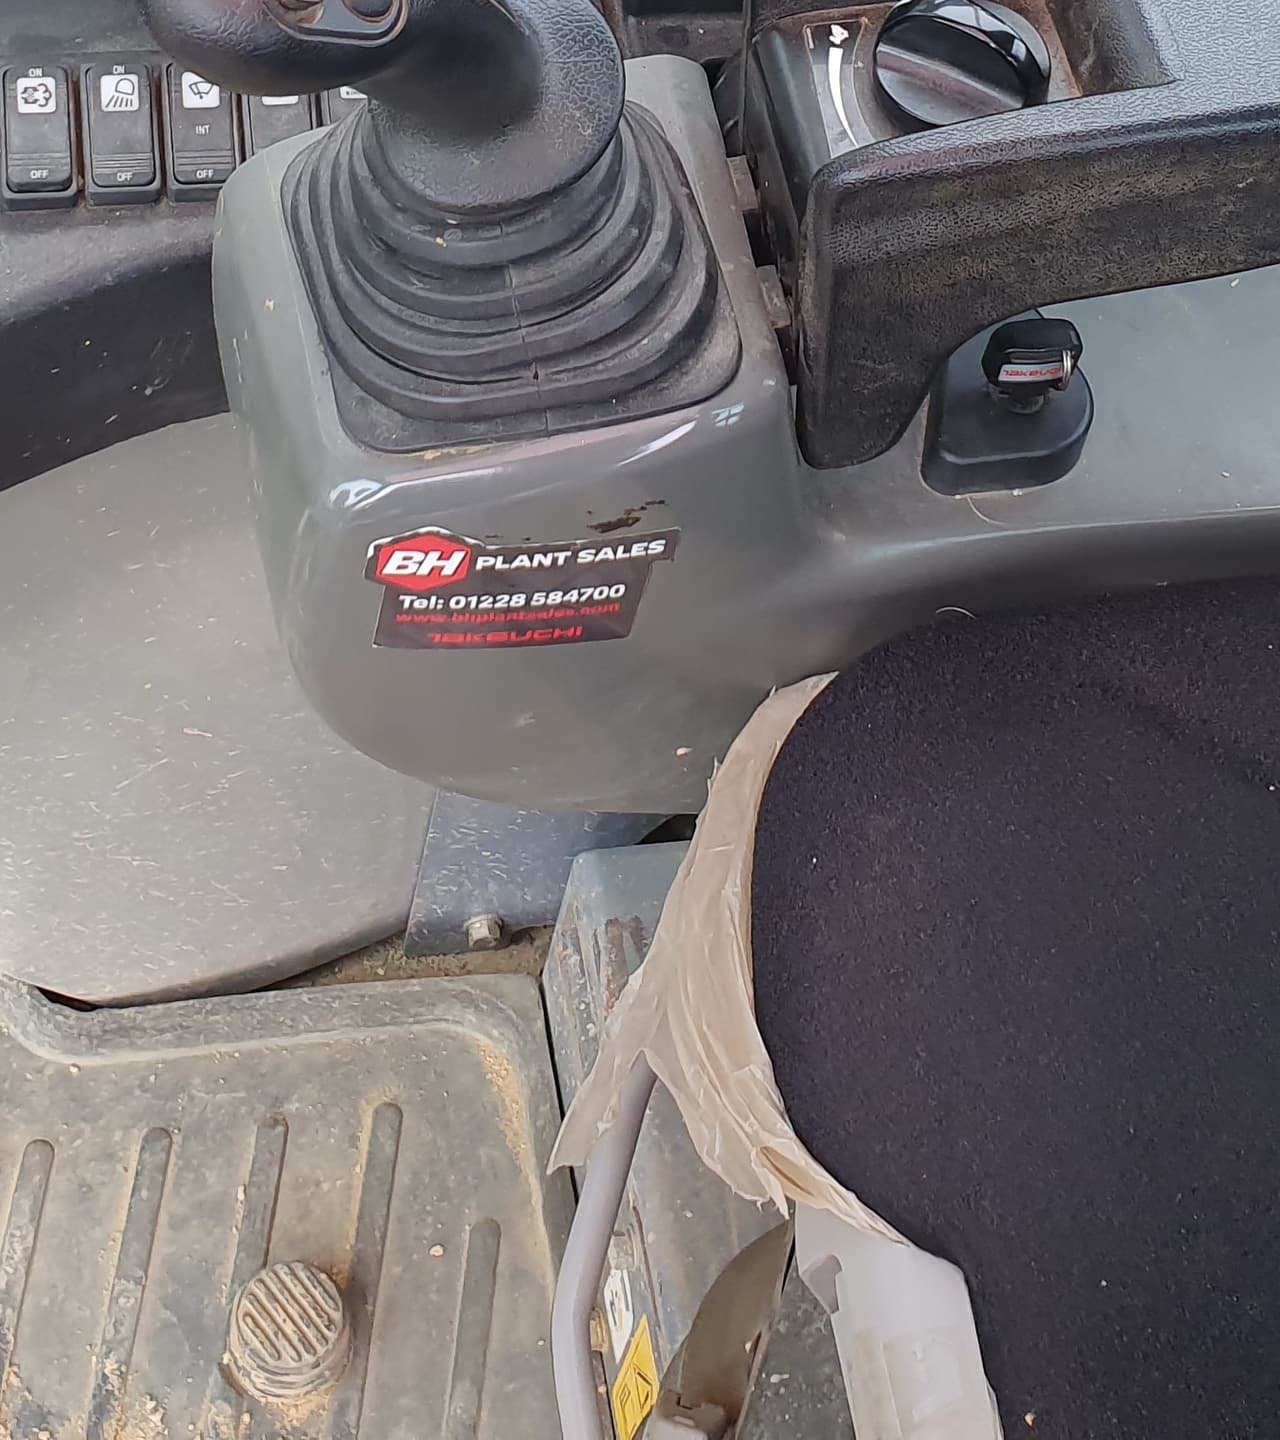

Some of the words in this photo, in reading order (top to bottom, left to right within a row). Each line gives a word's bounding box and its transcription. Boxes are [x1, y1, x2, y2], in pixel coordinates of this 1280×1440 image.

[28, 68, 43, 77] ON
[112, 65, 125, 75] ON
[195, 125, 210, 135] INT
[30, 169, 48, 179] OFF
[117, 172, 133, 182] OFF
[196, 169, 214, 179] OFF
[382, 550, 467, 576] BH
[476, 551, 571, 571] PLANT
[577, 540, 667, 564] SALES
[398, 594, 444, 610] Tel:
[449, 593, 526, 610] 01228
[530, 584, 626, 606] 584700
[427, 627, 584, 644] TAKEUCHI
